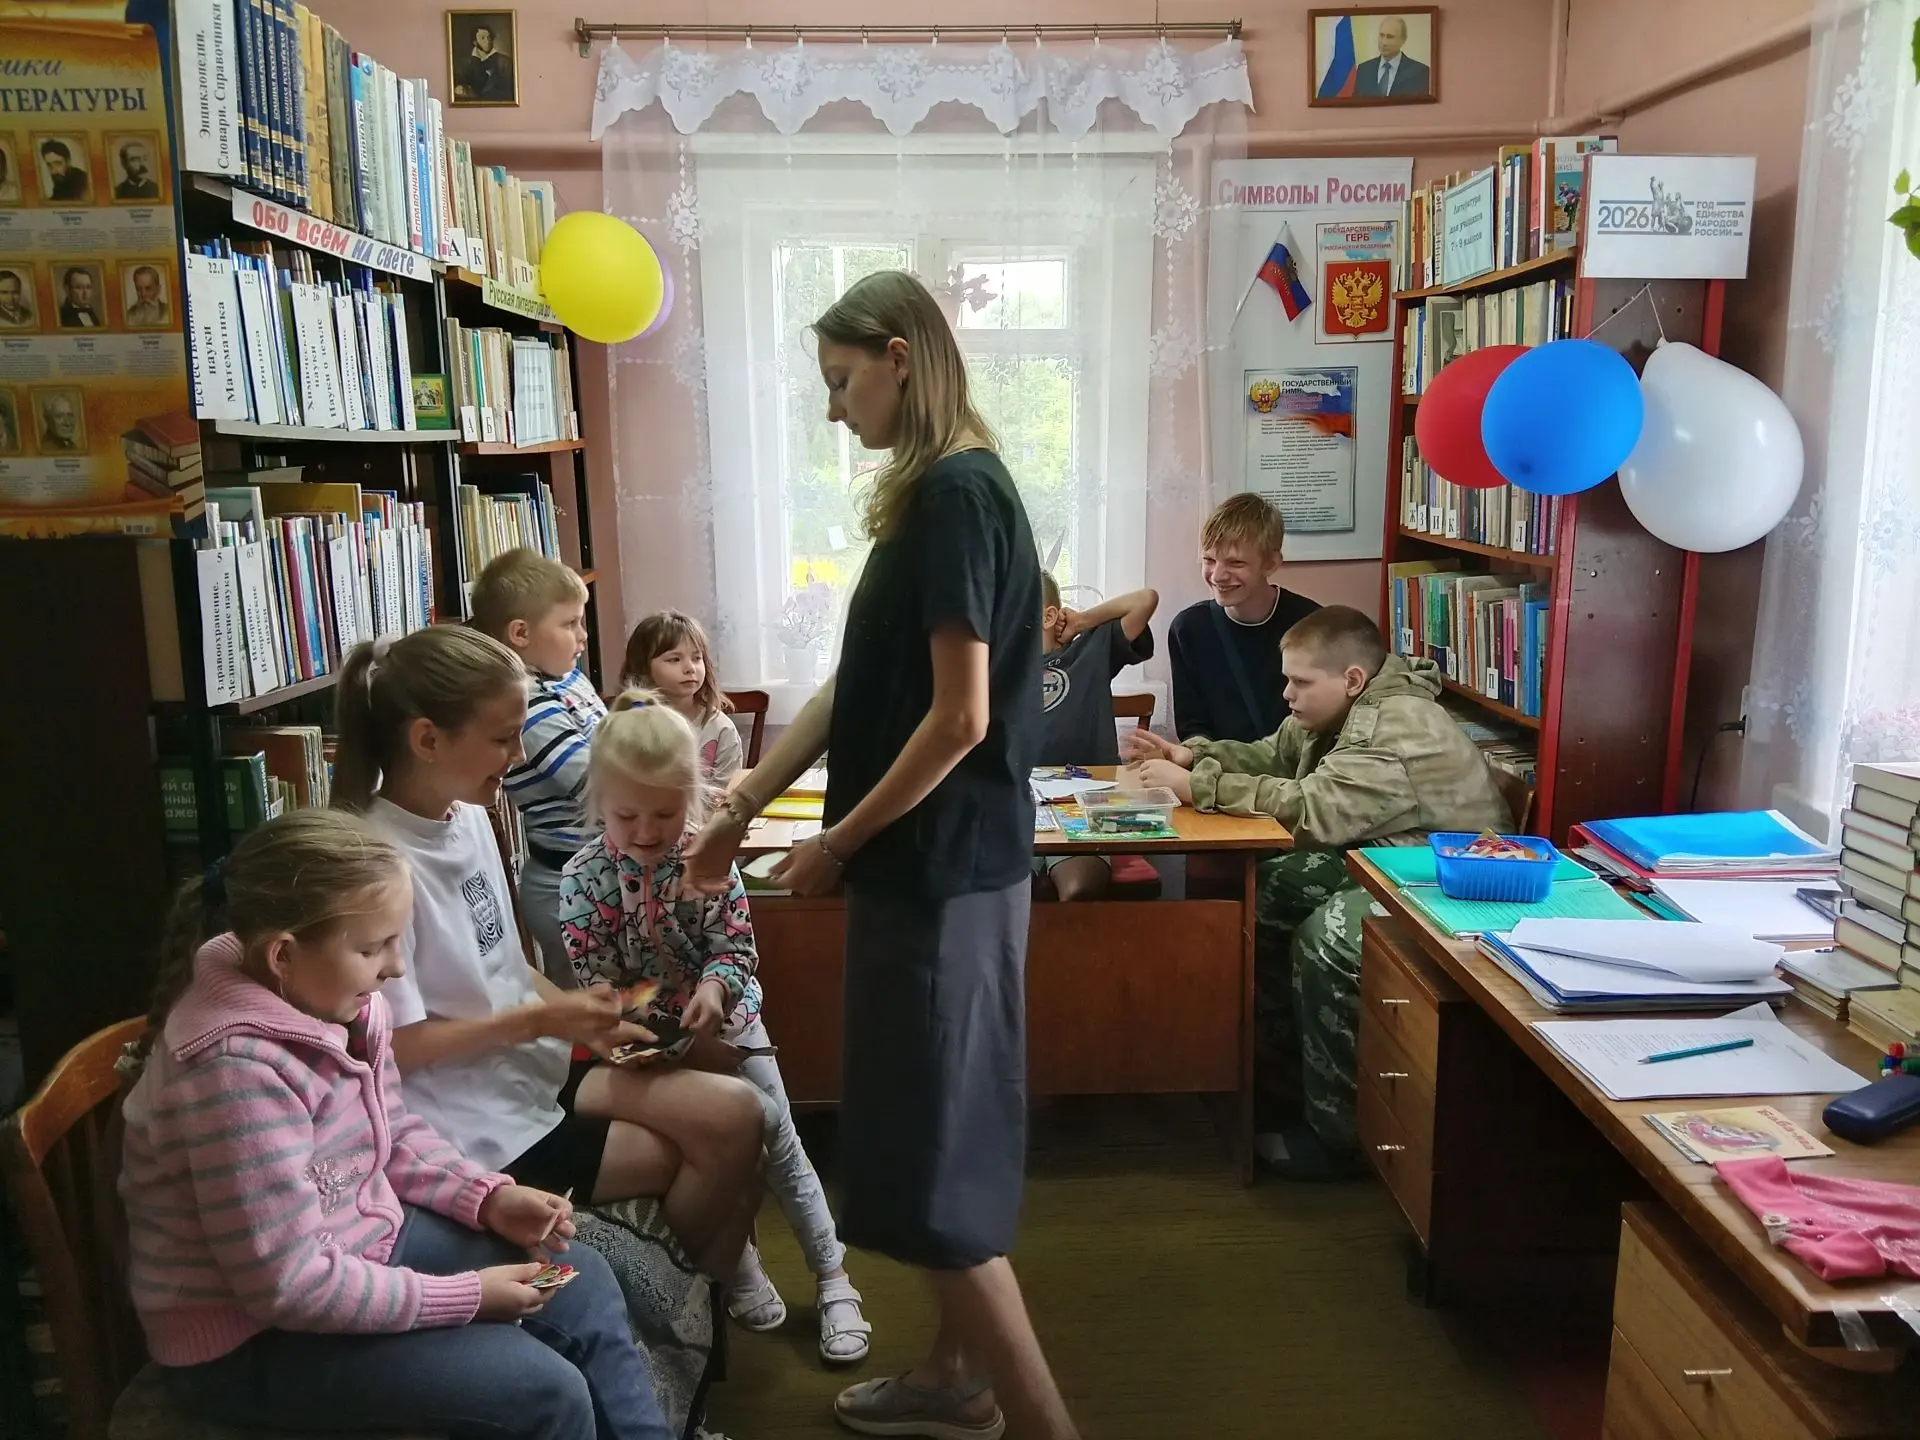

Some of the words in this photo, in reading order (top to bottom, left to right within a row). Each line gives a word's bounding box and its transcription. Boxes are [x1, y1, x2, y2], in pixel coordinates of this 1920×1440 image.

[212, 3, 226, 101] Справочники
[0, 87, 148, 112] ТЕРАТУРЫ
[215, 106, 229, 169] Словари.
[1218, 178, 1319, 206] Символы
[1326, 177, 1406, 204] России
[1695, 210, 1745, 218] ЕДИНСТВА
[1697, 201, 1714, 209] ГОД
[1598, 206, 1650, 228] 2026
[1695, 219, 1739, 227] НАРОДОВ
[252, 200, 289, 234] ОБО
[352, 239, 372, 266] НА
[1345, 233, 1370, 242] ГЕРБ
[1694, 228, 1732, 236] РОССИИ
[448, 239, 461, 257] А
[472, 247, 482, 265] К
[187, 257, 193, 269] 2
[204, 325, 217, 375] науки
[218, 301, 236, 403] Математика
[311, 345, 320, 388] науки
[1281, 379, 1352, 388] ГОСУДАРСТВЕННЫЙ
[325, 373, 336, 418] Науки
[467, 417, 474, 434] А
[486, 416, 492, 434] Б
[1433, 515, 1440, 530] И
[223, 571, 232, 611] науки
[212, 580, 225, 693] Здравоохранение.
[1488, 674, 1495, 689] П
